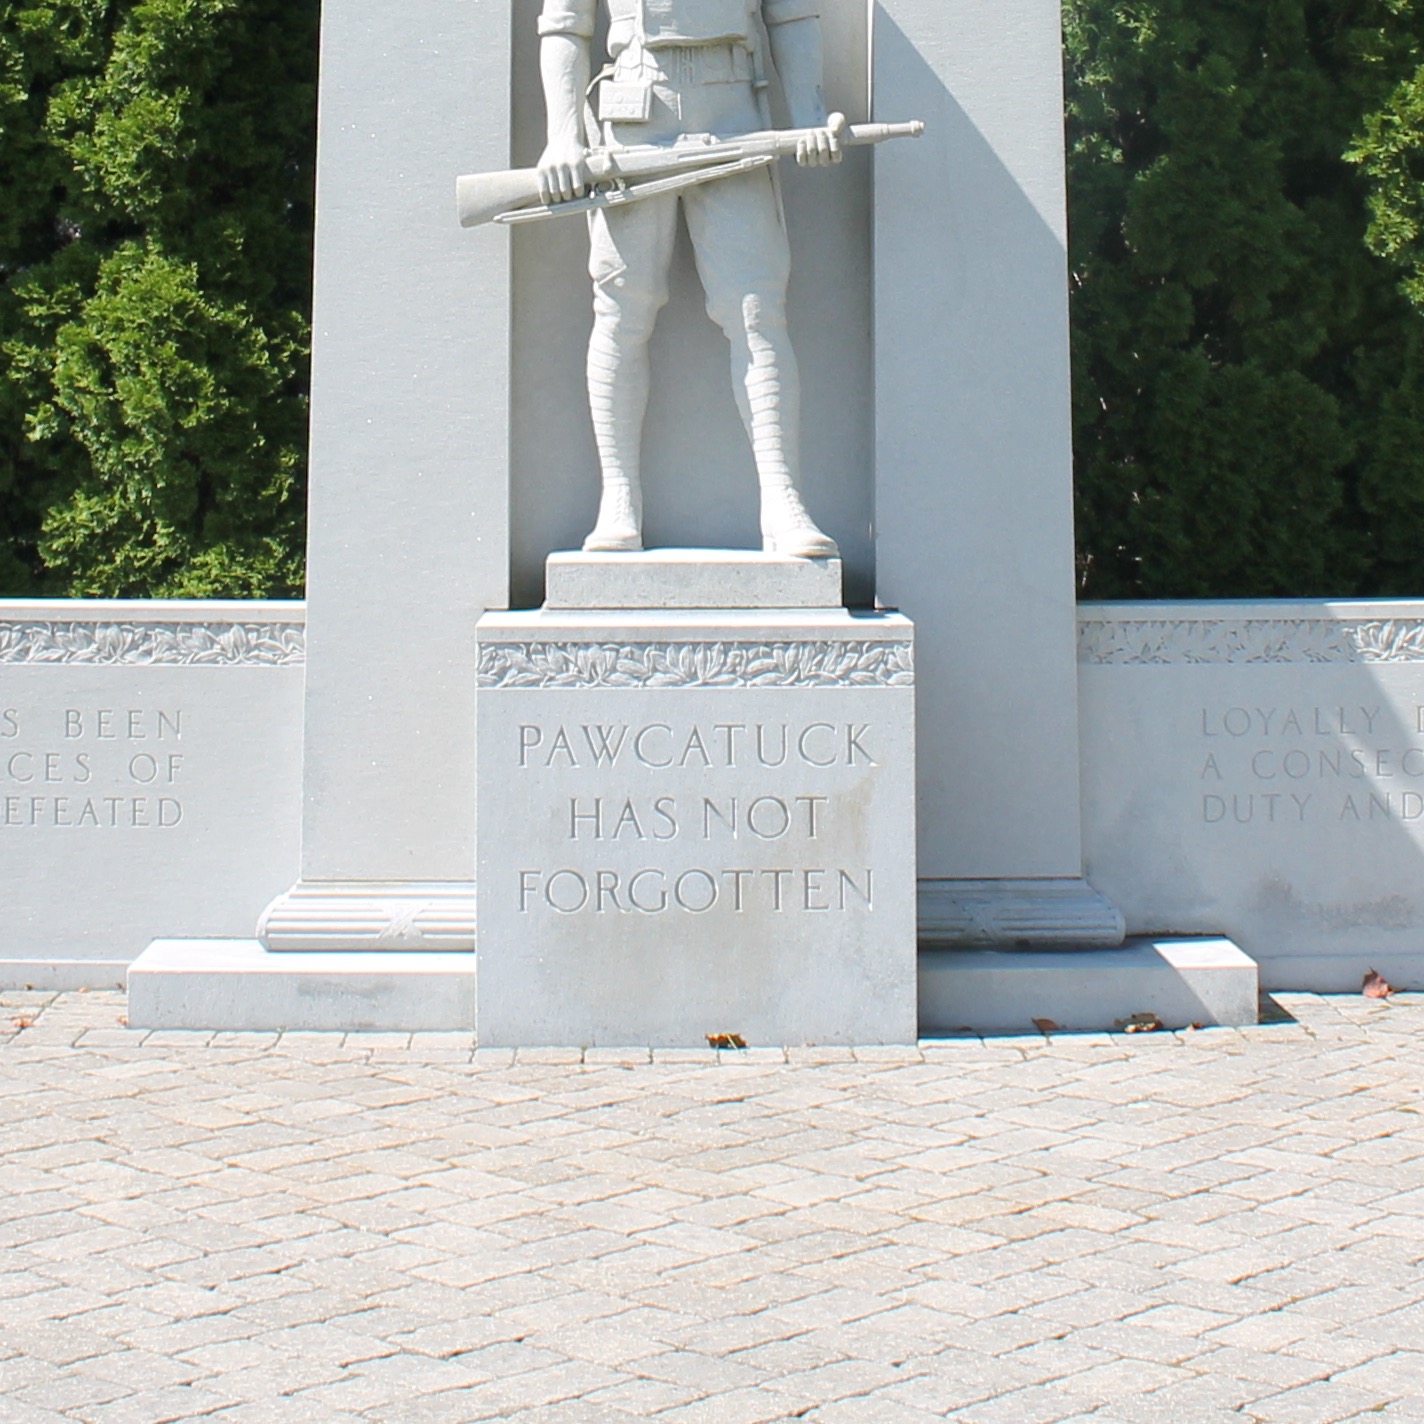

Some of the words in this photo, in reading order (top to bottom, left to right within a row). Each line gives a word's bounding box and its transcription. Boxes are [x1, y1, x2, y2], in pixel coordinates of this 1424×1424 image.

[65, 709, 182, 740] BEEN
[1201, 706, 1381, 736] LOYALLY
[518, 722, 879, 768] PAWCATUCK
[128, 753, 184, 784] OF
[1201, 752, 1223, 780] A
[569, 795, 680, 841] HAS
[702, 795, 828, 841] NOT
[1203, 793, 1312, 823] DUTY
[518, 868, 874, 914] FORGOTTEN
